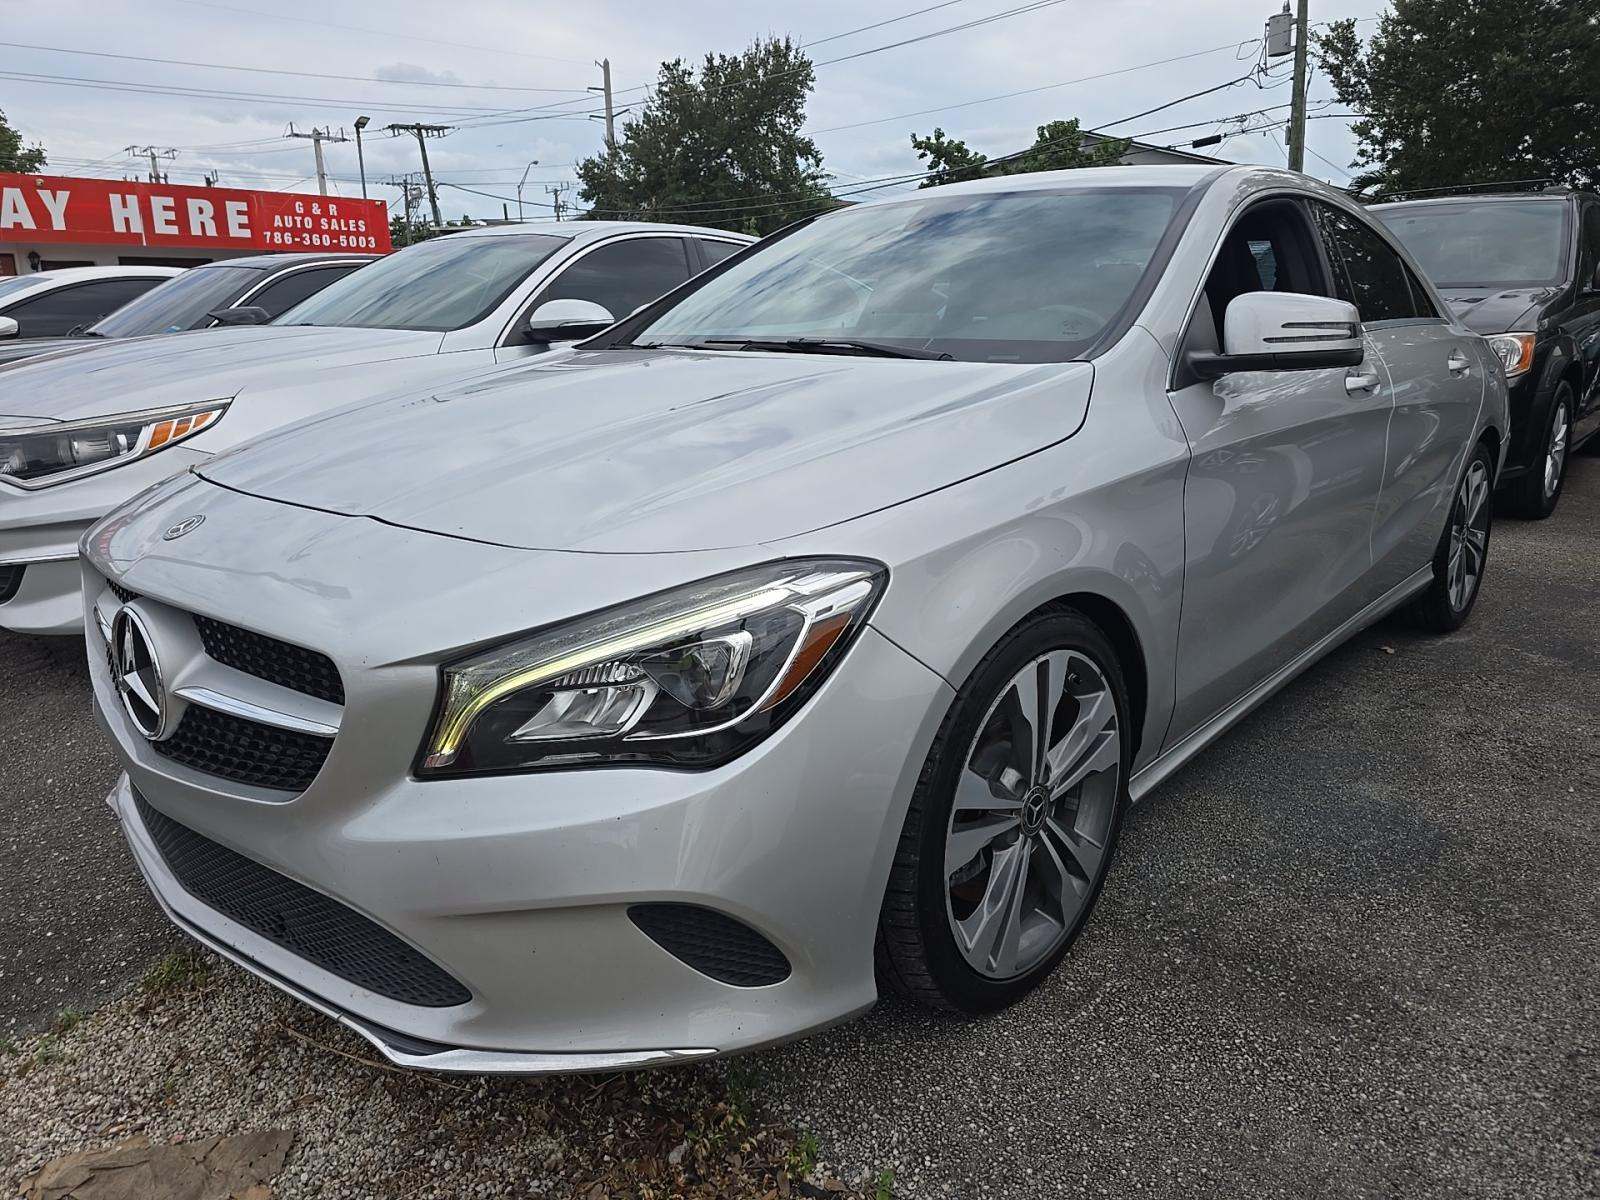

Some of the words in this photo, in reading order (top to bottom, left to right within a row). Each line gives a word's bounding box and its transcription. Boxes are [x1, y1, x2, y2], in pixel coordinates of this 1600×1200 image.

[109, 193, 252, 238] HERE
[295, 201, 304, 214] G
[312, 202, 322, 215] &
[328, 203, 338, 216] R
[273, 214, 313, 229] AUTO
[320, 217, 366, 232] SALES
[263, 231, 376, 248] 786-360-5003
